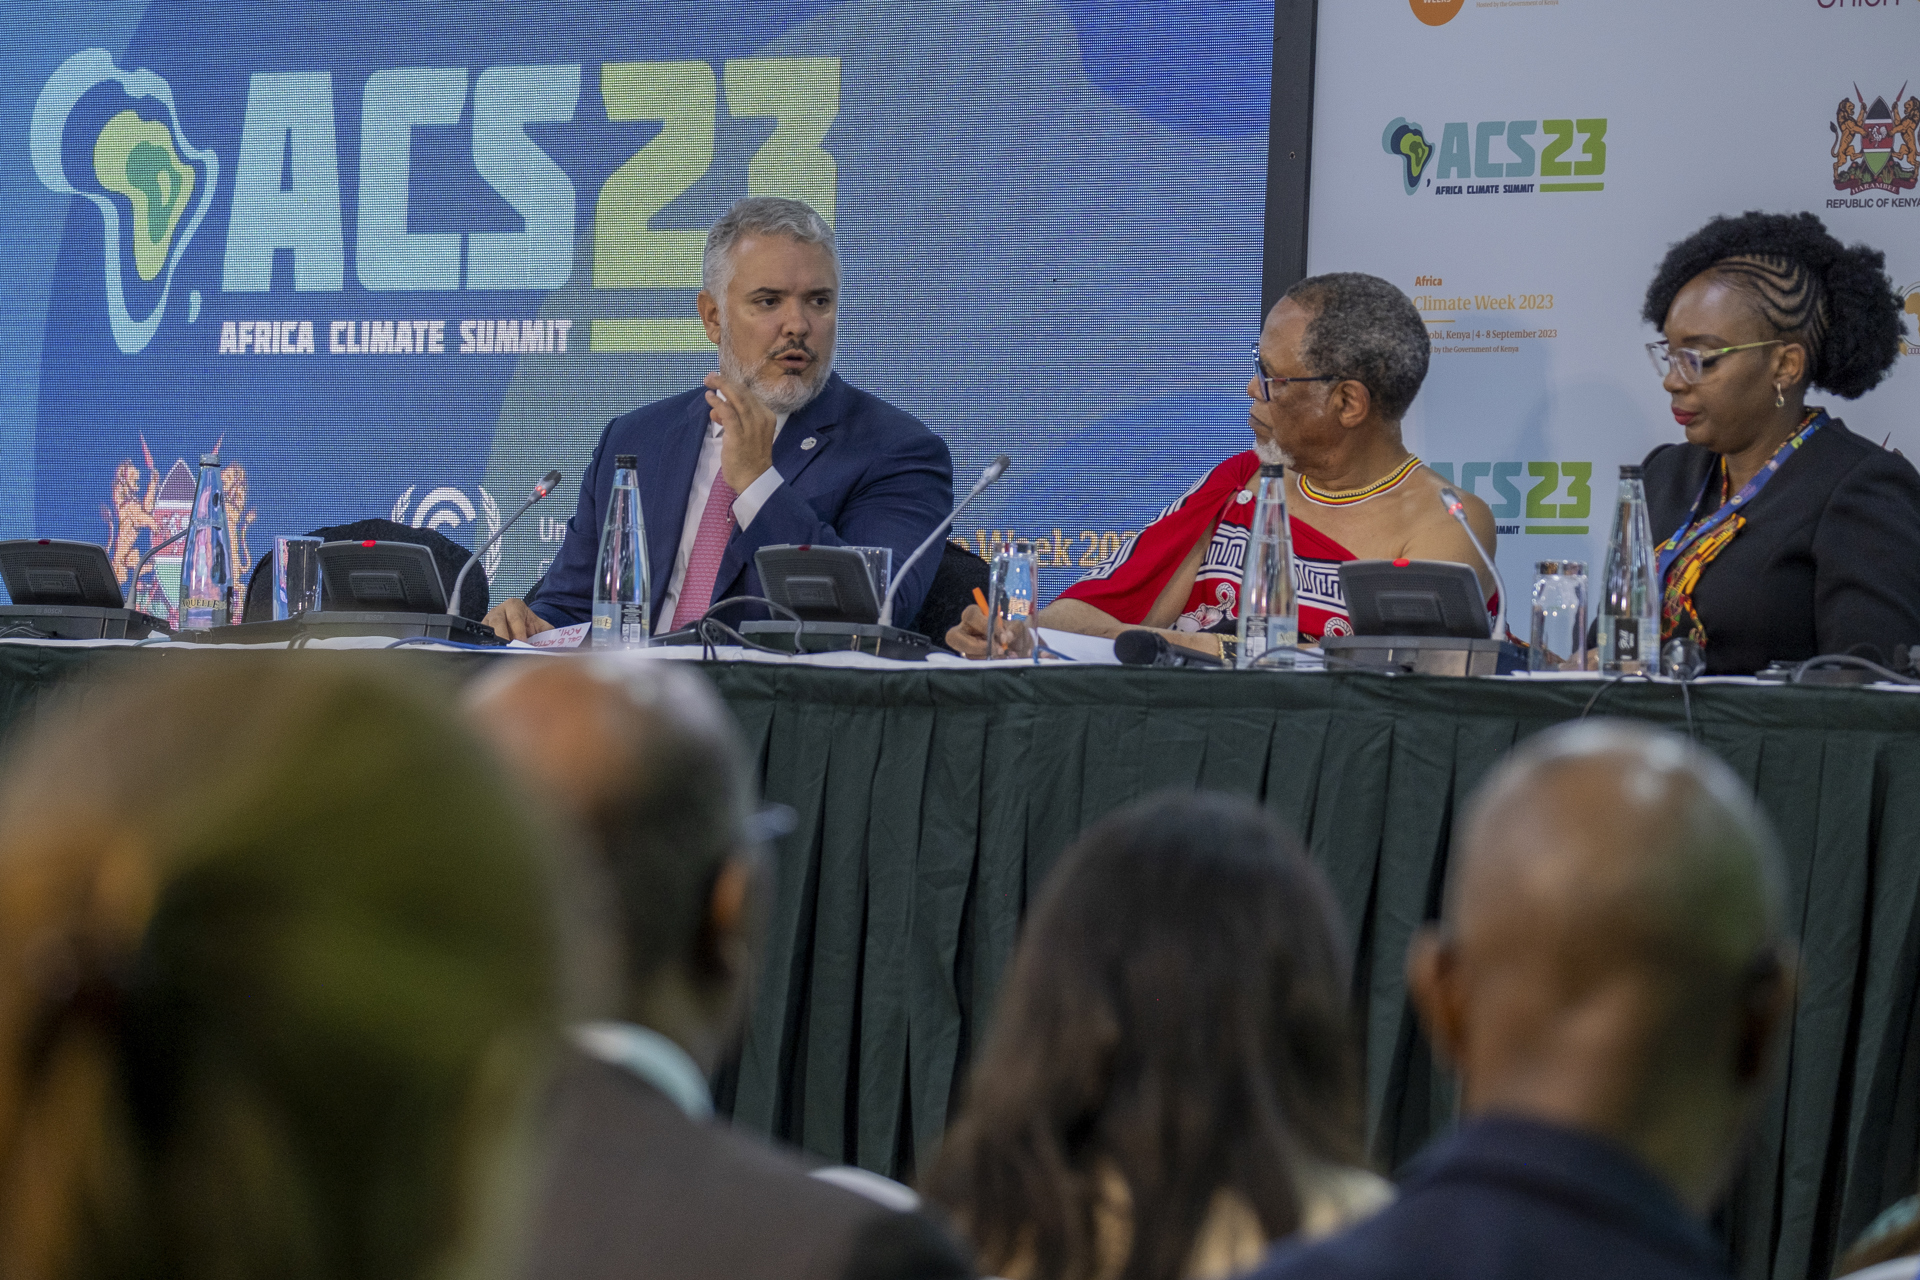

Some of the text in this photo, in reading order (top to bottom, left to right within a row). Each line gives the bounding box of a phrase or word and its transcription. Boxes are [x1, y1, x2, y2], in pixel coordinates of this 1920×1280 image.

[1436, 118, 1608, 180] ACS23
[222, 57, 842, 292] ACS23
[1435, 184, 1535, 195] AFRICA CLIMATE SUMMIT
[1851, 182, 1898, 195] HARAMBEE
[1826, 198, 1874, 209] REPUBLIC
[1876, 198, 1890, 208] OF
[1414, 275, 1443, 287] Africa
[1412, 294, 1554, 312] Climate Week 2023
[219, 319, 573, 355] AFRICA CLIMATE SUMMIT
[1446, 330, 1471, 341] Kenya
[1475, 330, 1481, 338] 4
[1486, 330, 1491, 338] 8
[1492, 329, 1537, 341] September
[1538, 329, 1558, 338] 2023
[1434, 346, 1441, 354] by
[1453, 345, 1492, 353] Government
[1492, 345, 1500, 353] of
[1500, 345, 1519, 354] Kenya
[1496, 525, 1520, 535] MMIT
